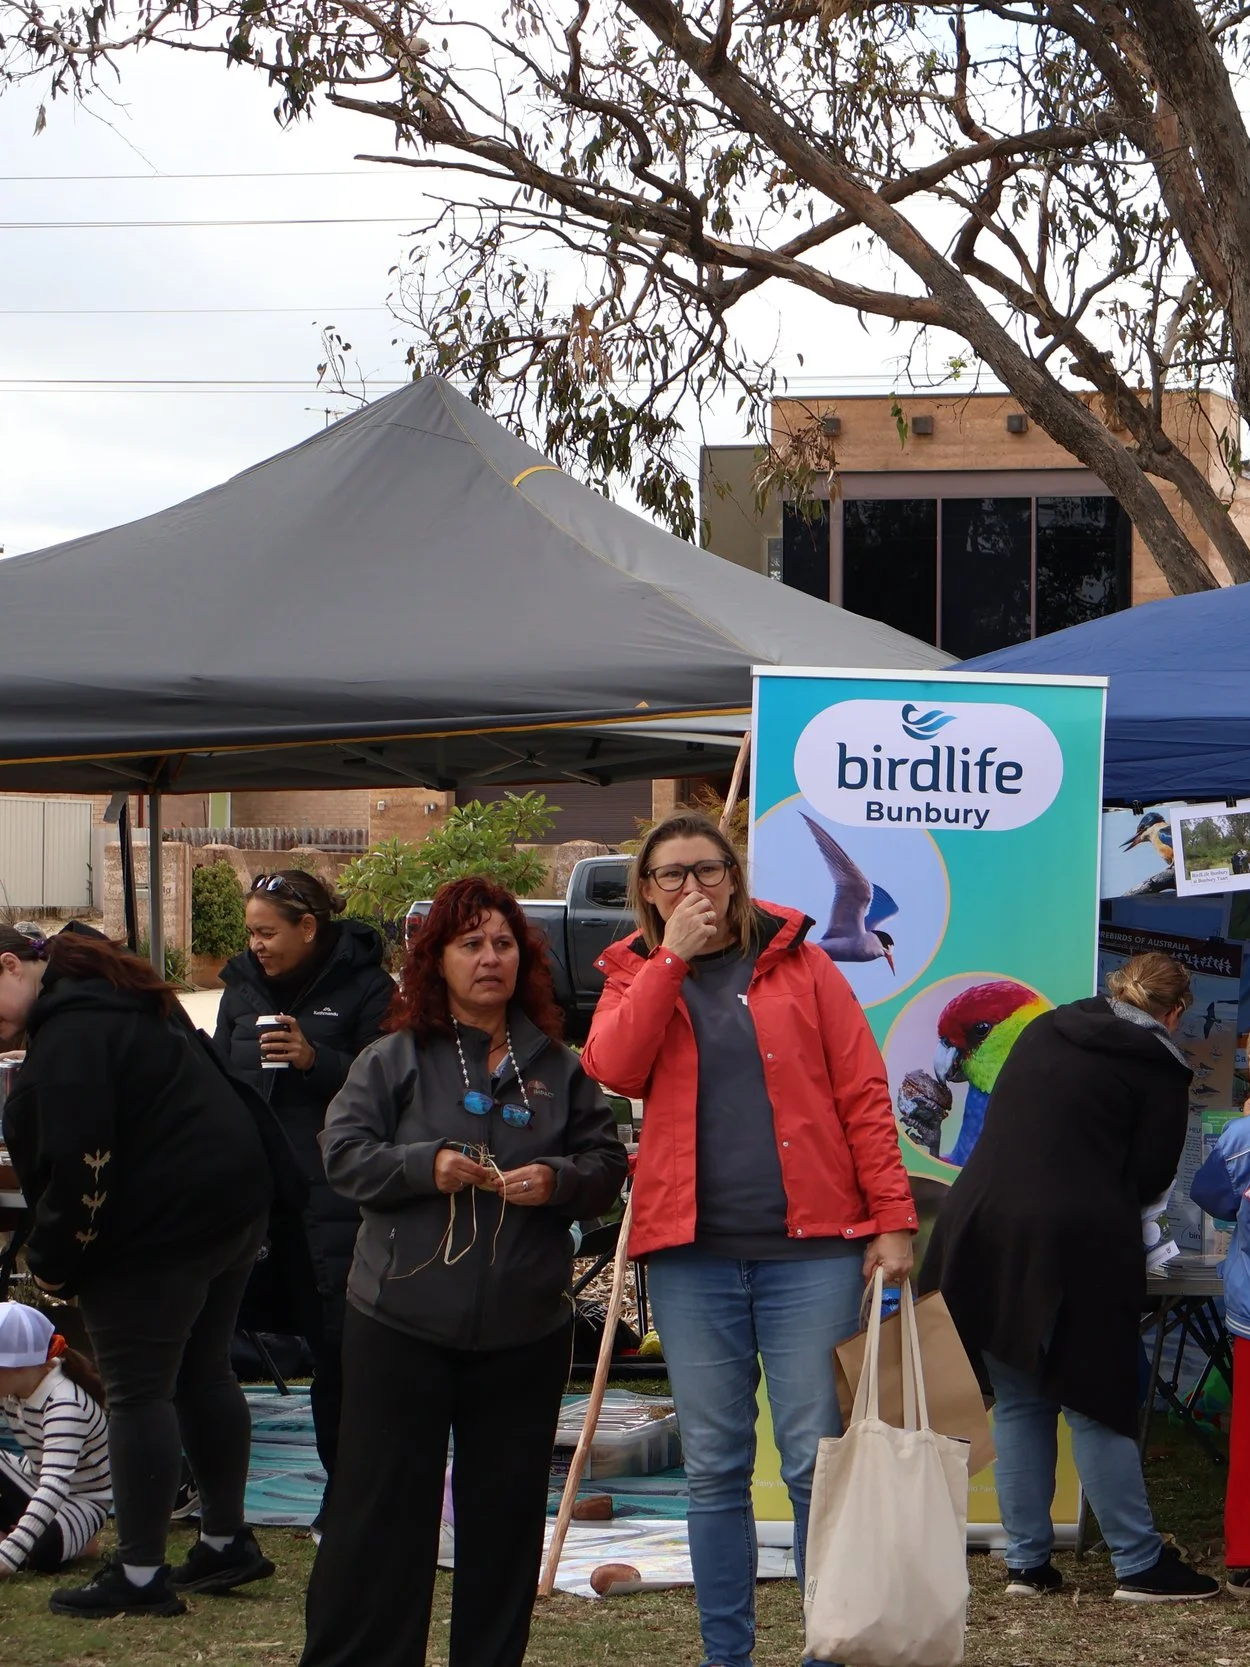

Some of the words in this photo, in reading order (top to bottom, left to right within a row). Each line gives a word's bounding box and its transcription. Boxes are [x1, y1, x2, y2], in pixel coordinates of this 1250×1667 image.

[836, 742, 1023, 795] birdlife
[866, 801, 991, 830] Bunbury
[1100, 930, 1133, 943] REBIRDS
[1134, 936, 1146, 944] OF
[1147, 938, 1190, 951] AUSTRALIA
